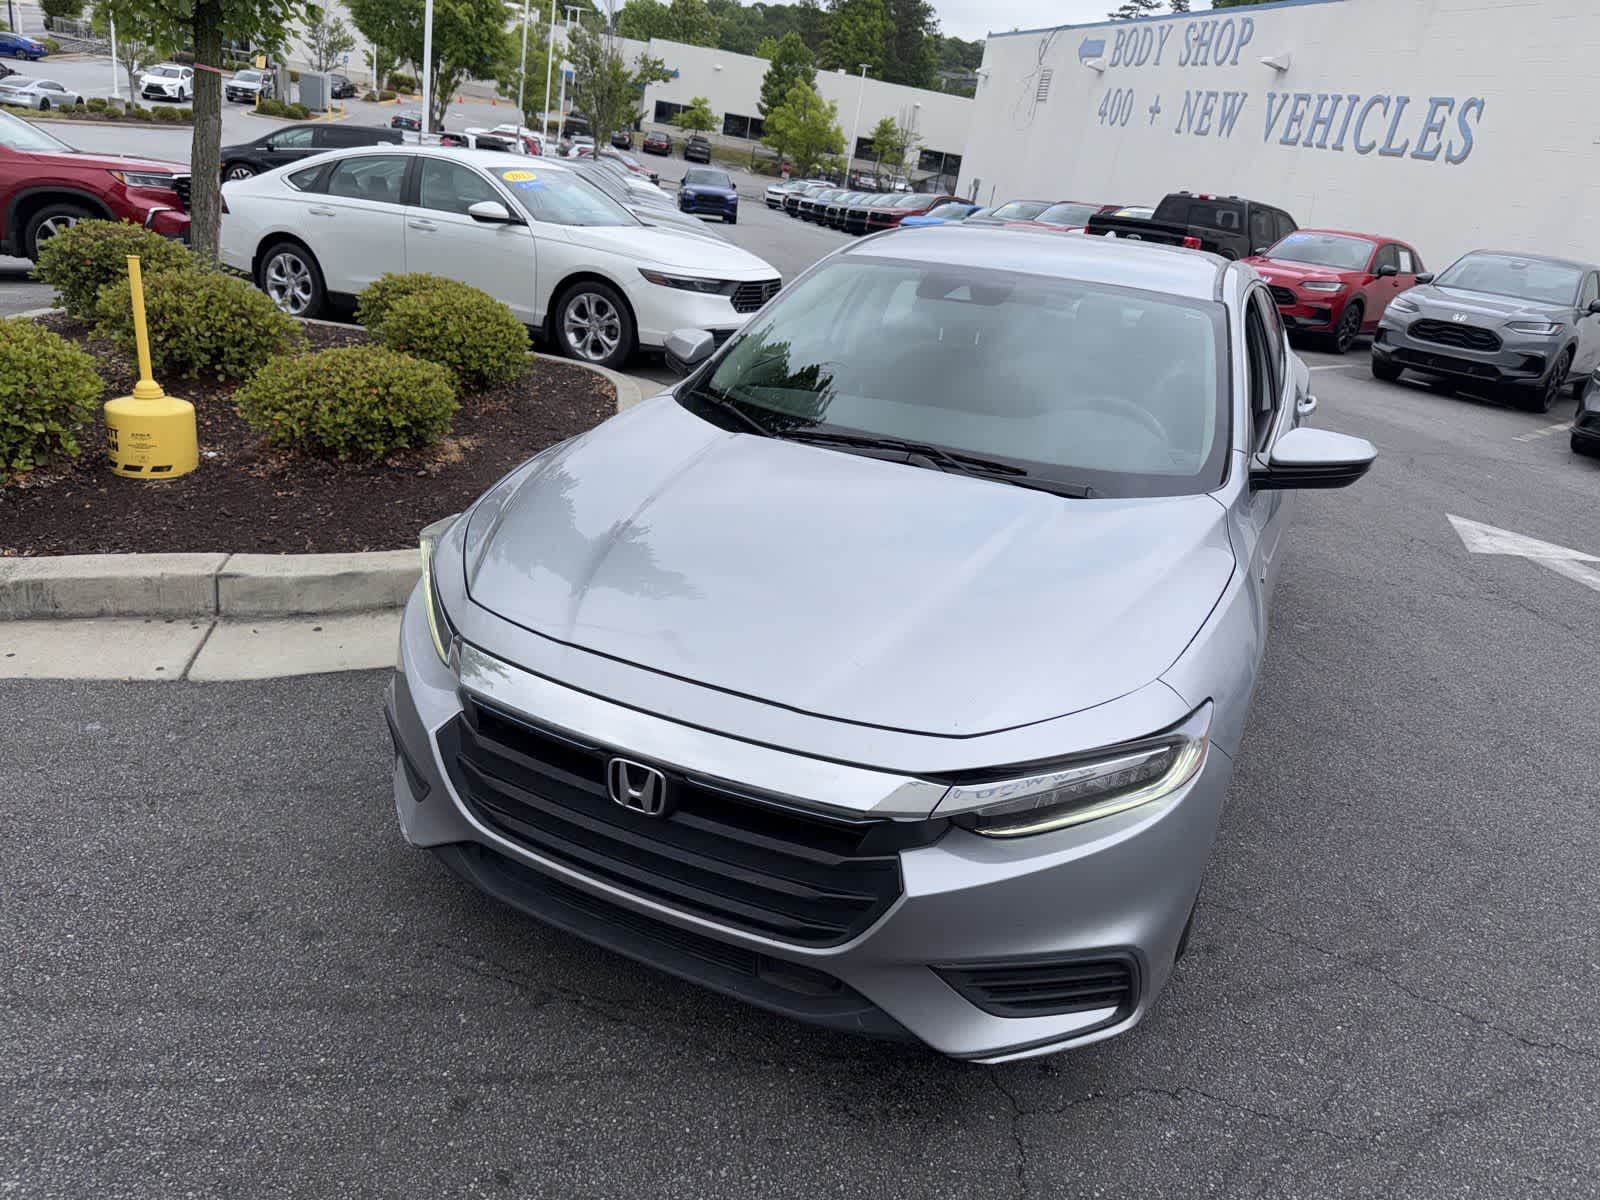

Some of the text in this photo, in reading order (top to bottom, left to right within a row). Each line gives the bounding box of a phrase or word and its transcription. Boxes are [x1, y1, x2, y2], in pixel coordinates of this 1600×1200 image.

[1109, 17, 1255, 67] BODY SHOP
[1098, 88, 1485, 165] 400 + NEW VEHICLES
